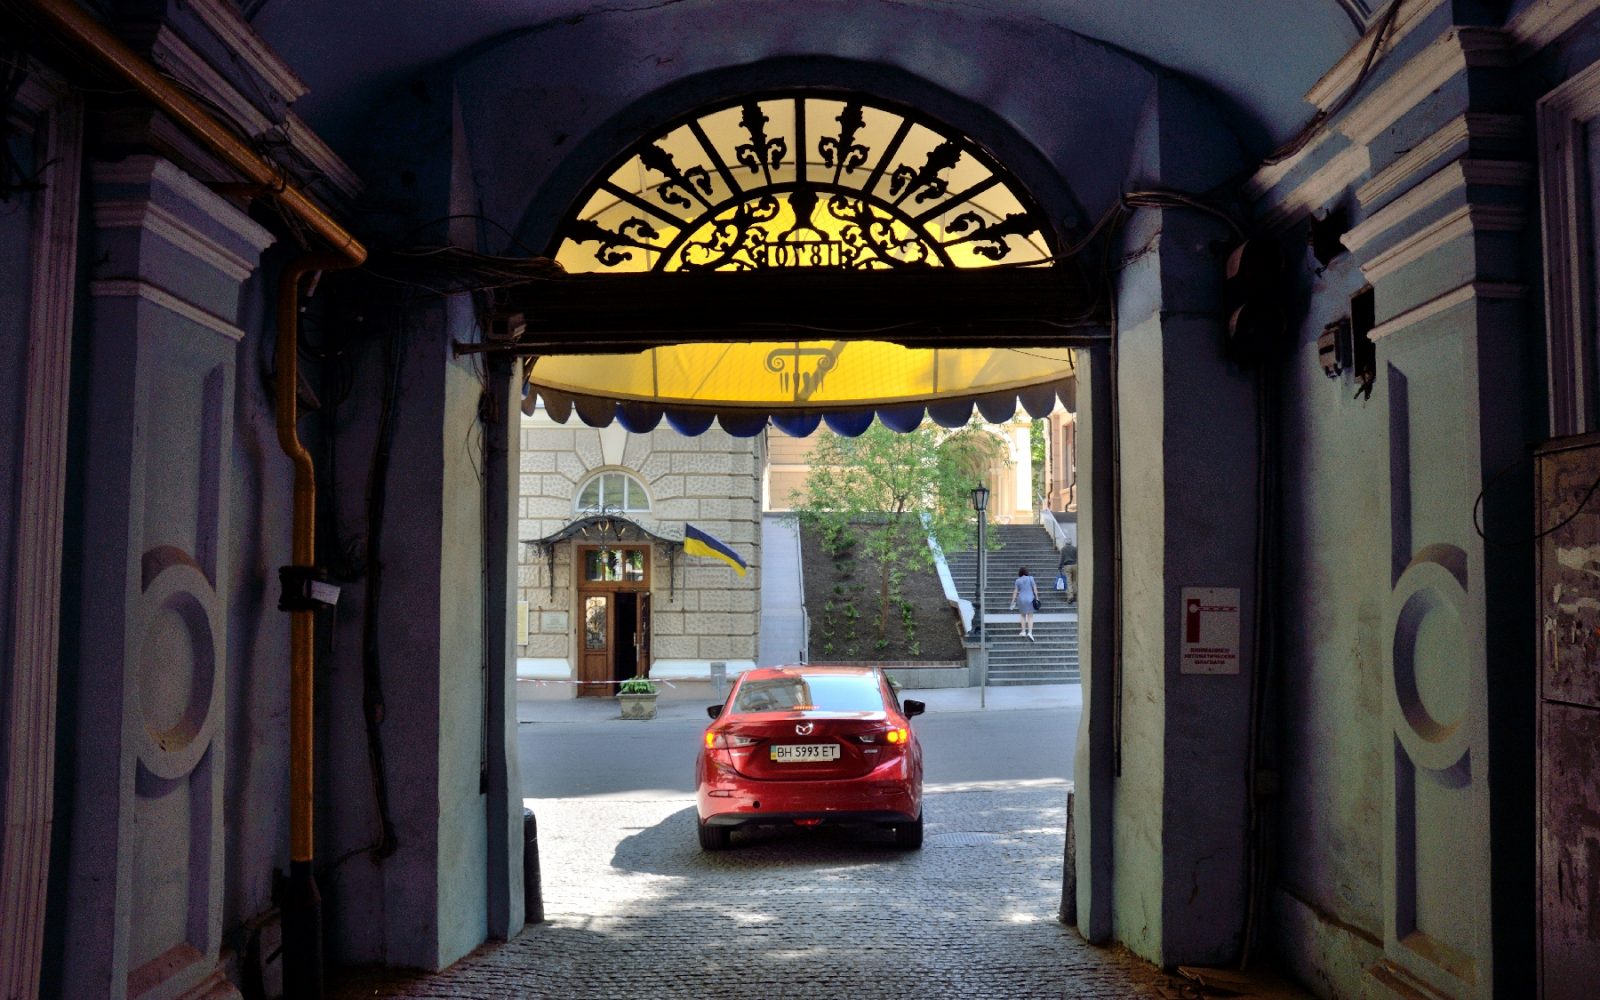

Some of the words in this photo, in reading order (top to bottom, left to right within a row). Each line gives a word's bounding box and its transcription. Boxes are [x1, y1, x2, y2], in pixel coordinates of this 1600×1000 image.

[777, 747, 792, 758] BH
[795, 746, 819, 758] 5993
[822, 745, 837, 757] ET
